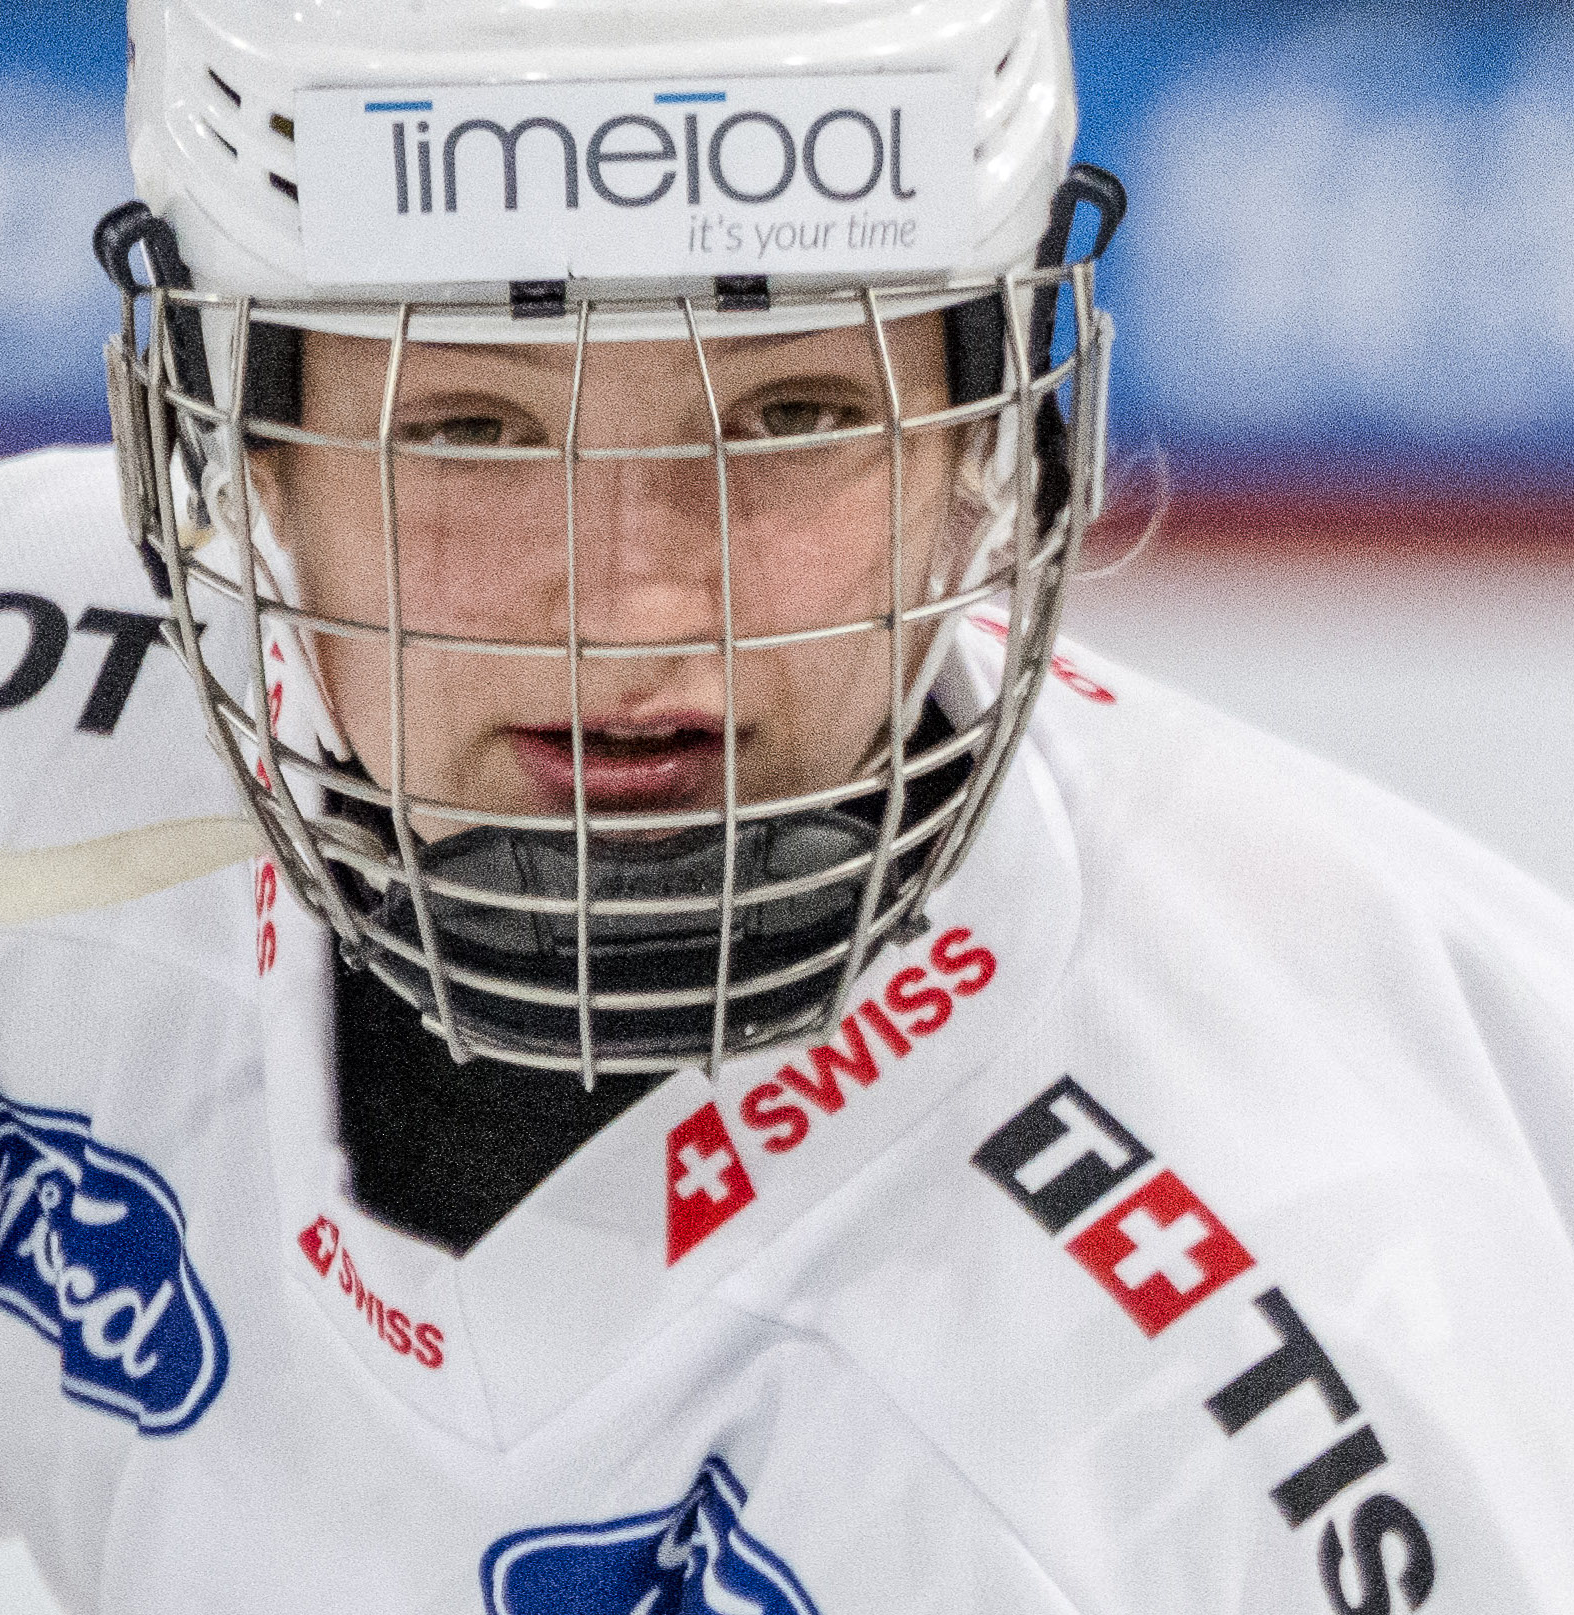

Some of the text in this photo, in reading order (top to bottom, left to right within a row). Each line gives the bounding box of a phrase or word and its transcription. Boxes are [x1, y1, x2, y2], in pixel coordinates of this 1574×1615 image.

[363, 91, 917, 215] TimeTool
[689, 211, 917, 261] it's your time
[739, 926, 998, 1155] SWISS
[337, 1246, 445, 1370] SWISS
